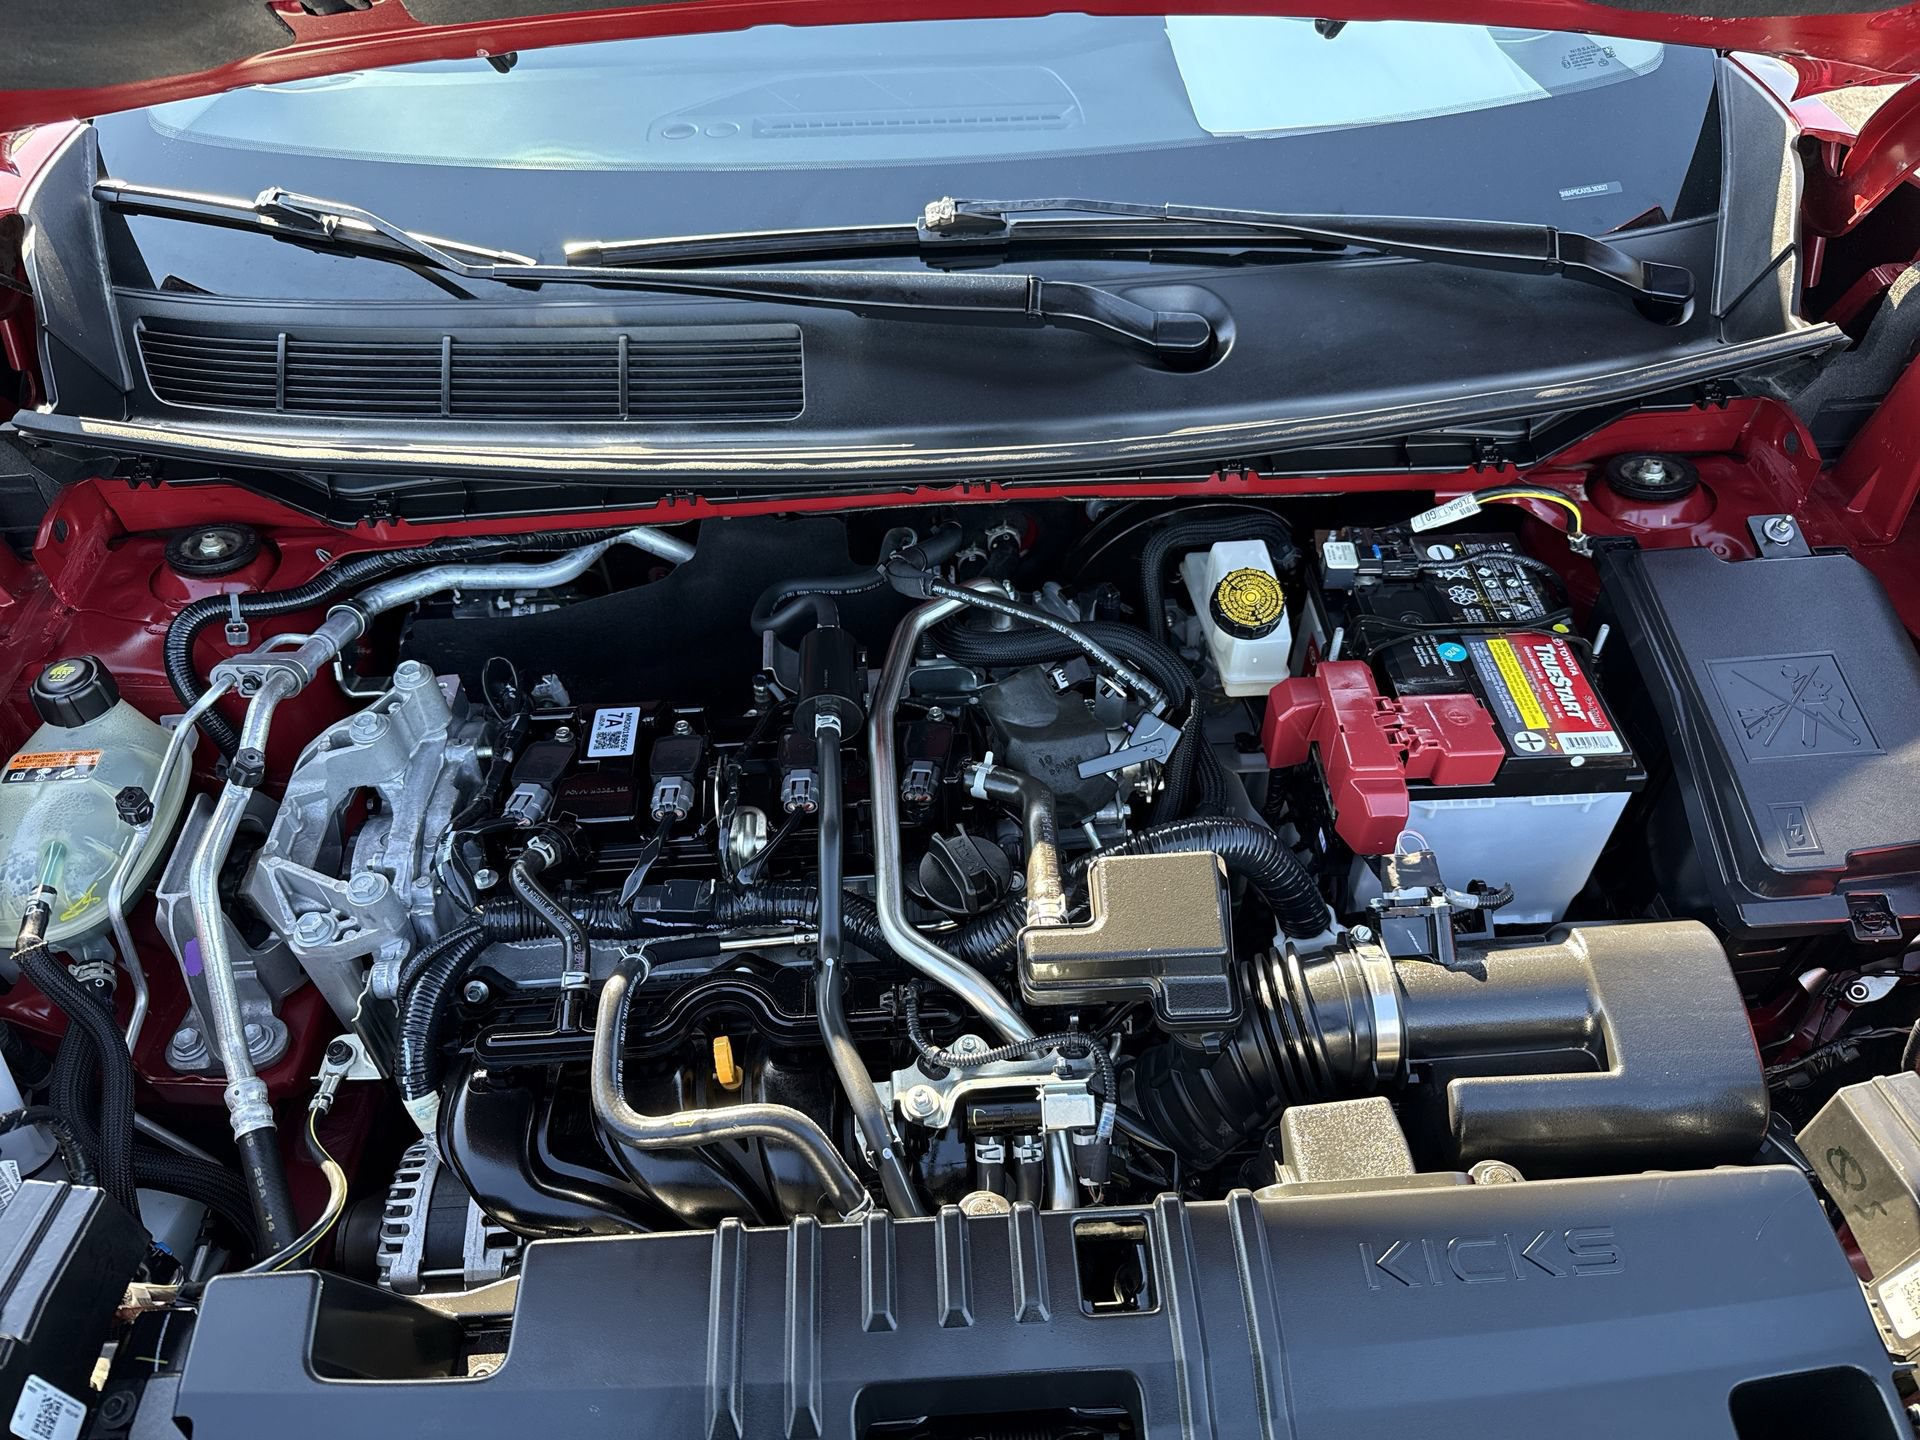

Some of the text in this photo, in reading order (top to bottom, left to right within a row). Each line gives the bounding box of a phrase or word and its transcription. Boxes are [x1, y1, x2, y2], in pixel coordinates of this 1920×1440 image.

[1560, 647, 1579, 677] TOYOTA
[605, 712, 624, 728] 7A
[254, 1167, 266, 1198] 25A
[266, 1214, 275, 1232] 14
[1358, 1226, 1627, 1291] KICKS
